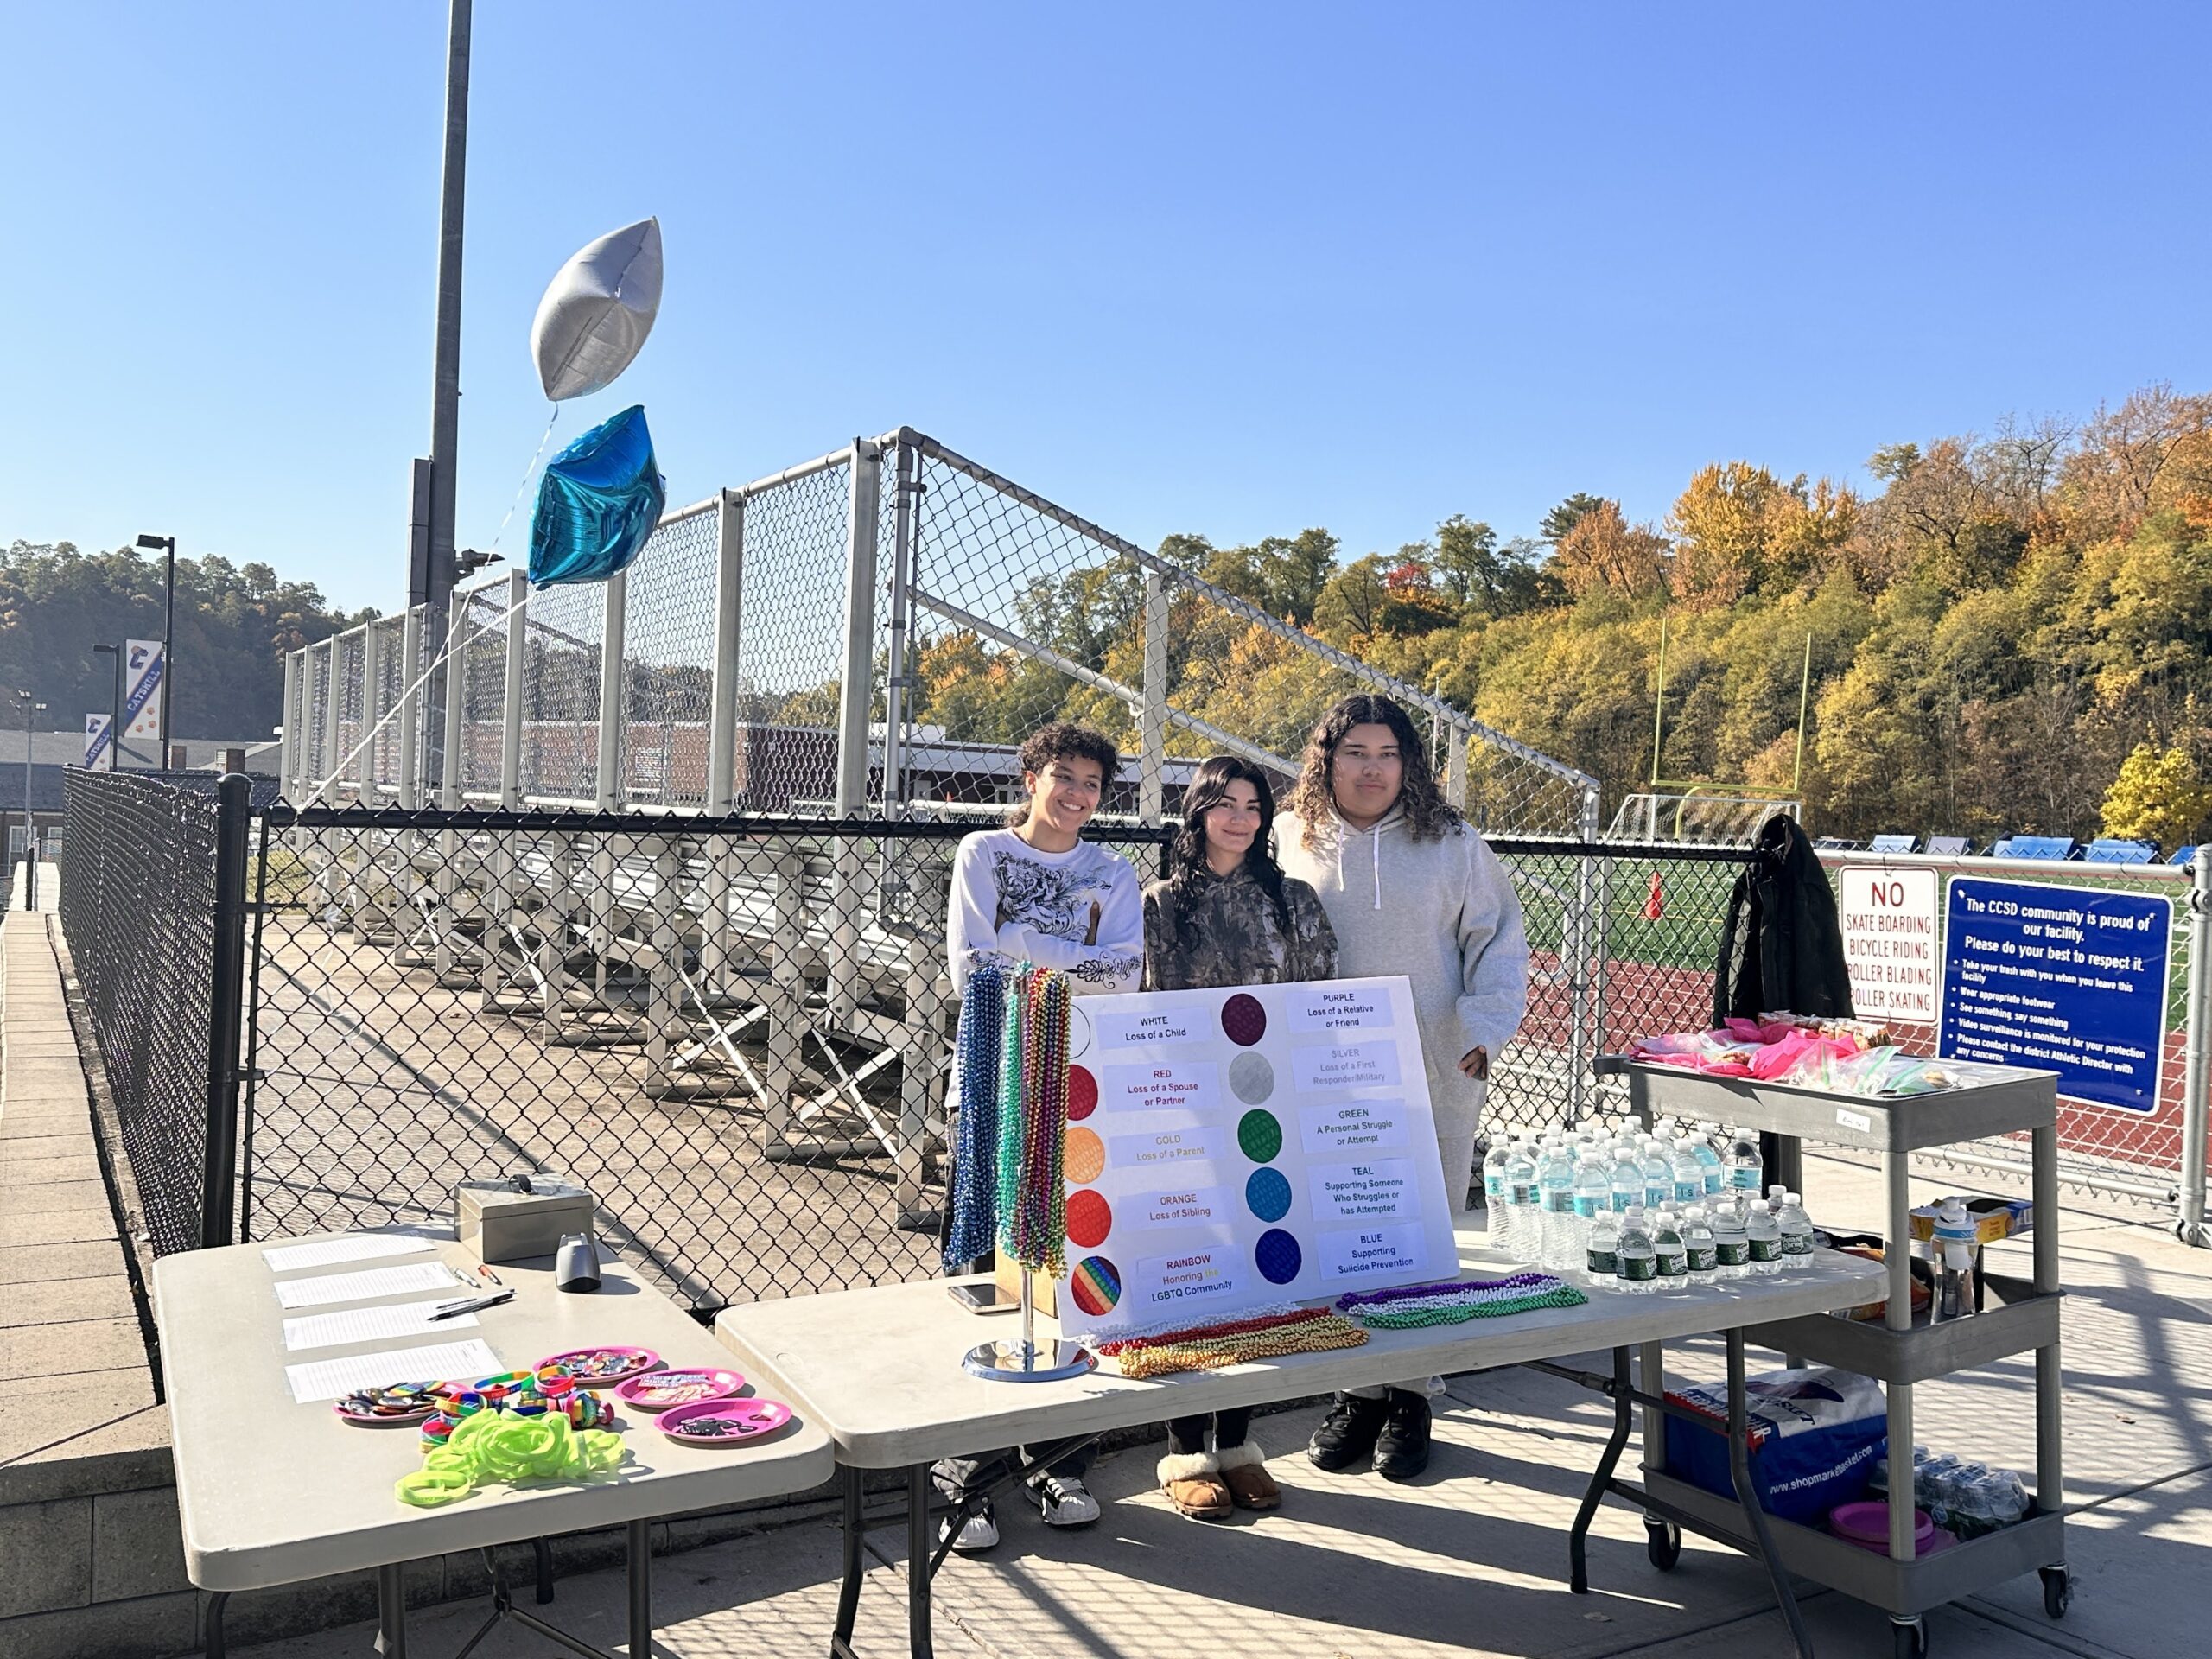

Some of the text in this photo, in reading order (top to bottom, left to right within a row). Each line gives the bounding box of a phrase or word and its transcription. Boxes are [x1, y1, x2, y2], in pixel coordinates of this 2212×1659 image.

[127, 671, 162, 711] CATSKILL
[86, 734, 110, 762] CATSKILL
[1872, 882, 1904, 907] NO
[1967, 898, 2150, 931] The CCSD community is proud of
[1847, 913, 1931, 934] SKATE BOARDING
[2023, 924, 2085, 944] our facility.
[1850, 938, 1929, 960] BICYCLE RIDING
[1965, 935, 2145, 972] Please do your best to respect it.
[1847, 963, 1932, 986] ROLLER BLADING
[1962, 959, 2133, 992] Take your trash with you when you leave this
[1962, 971, 1986, 984] facility
[1323, 993, 1355, 1002] PURPLE
[1889, 991, 1930, 1011] SKATING
[1961, 986, 2056, 1009] Wear appropriate footwear
[1328, 1007, 1335, 1015] of
[1344, 1005, 1374, 1014] Relative
[1141, 1016, 1168, 1026] WHITE
[1335, 1018, 1359, 1027] Friend
[1960, 1002, 1973, 1013] See
[2014, 1012, 2028, 1023] say
[2030, 1014, 2069, 1031] something
[1148, 1031, 1156, 1039] of
[1166, 1028, 1186, 1037] Child
[1958, 1018, 2146, 1059] Video surveillance is monitored for your protection
[1332, 1048, 1360, 1058] SILVER
[1956, 1046, 2004, 1062] any concerns
[1957, 1033, 2133, 1074] Please contact the district Athletic Director with
[1341, 1062, 1348, 1071] of
[1357, 1060, 1376, 1069] First
[1154, 1070, 1172, 1078] RED
[1150, 1084, 1159, 1092] of
[1168, 1083, 1198, 1092] Spouse
[1156, 1096, 1185, 1105] Partner
[1338, 1109, 1370, 1119] GREEN
[1325, 1123, 1360, 1134] Personal
[1362, 1120, 1393, 1130] Struggle
[1155, 1135, 1180, 1145] GOLD
[1347, 1134, 1379, 1144] Attempt
[1159, 1150, 1167, 1159] of
[1177, 1147, 1205, 1156] Parent
[1351, 1166, 1374, 1176] TEAL
[1325, 1179, 1404, 1192] Supporting Someone
[1160, 1194, 1197, 1205] ORANGE
[1333, 1194, 1351, 1203] Who
[1353, 1192, 1389, 1202] Struggles
[1172, 1210, 1179, 1218] of
[1182, 1208, 1211, 1217] Sibling
[1341, 1204, 1396, 1215] has Attempted
[1360, 1234, 1382, 1244] BLUE
[1352, 1247, 1396, 1259] Supporting
[1167, 1255, 1211, 1269] RAINBOW
[1371, 1258, 1414, 1270] Prevention
[1163, 1269, 1219, 1285] Honoring the
[1151, 1281, 1232, 1301] LGBTQ Community
